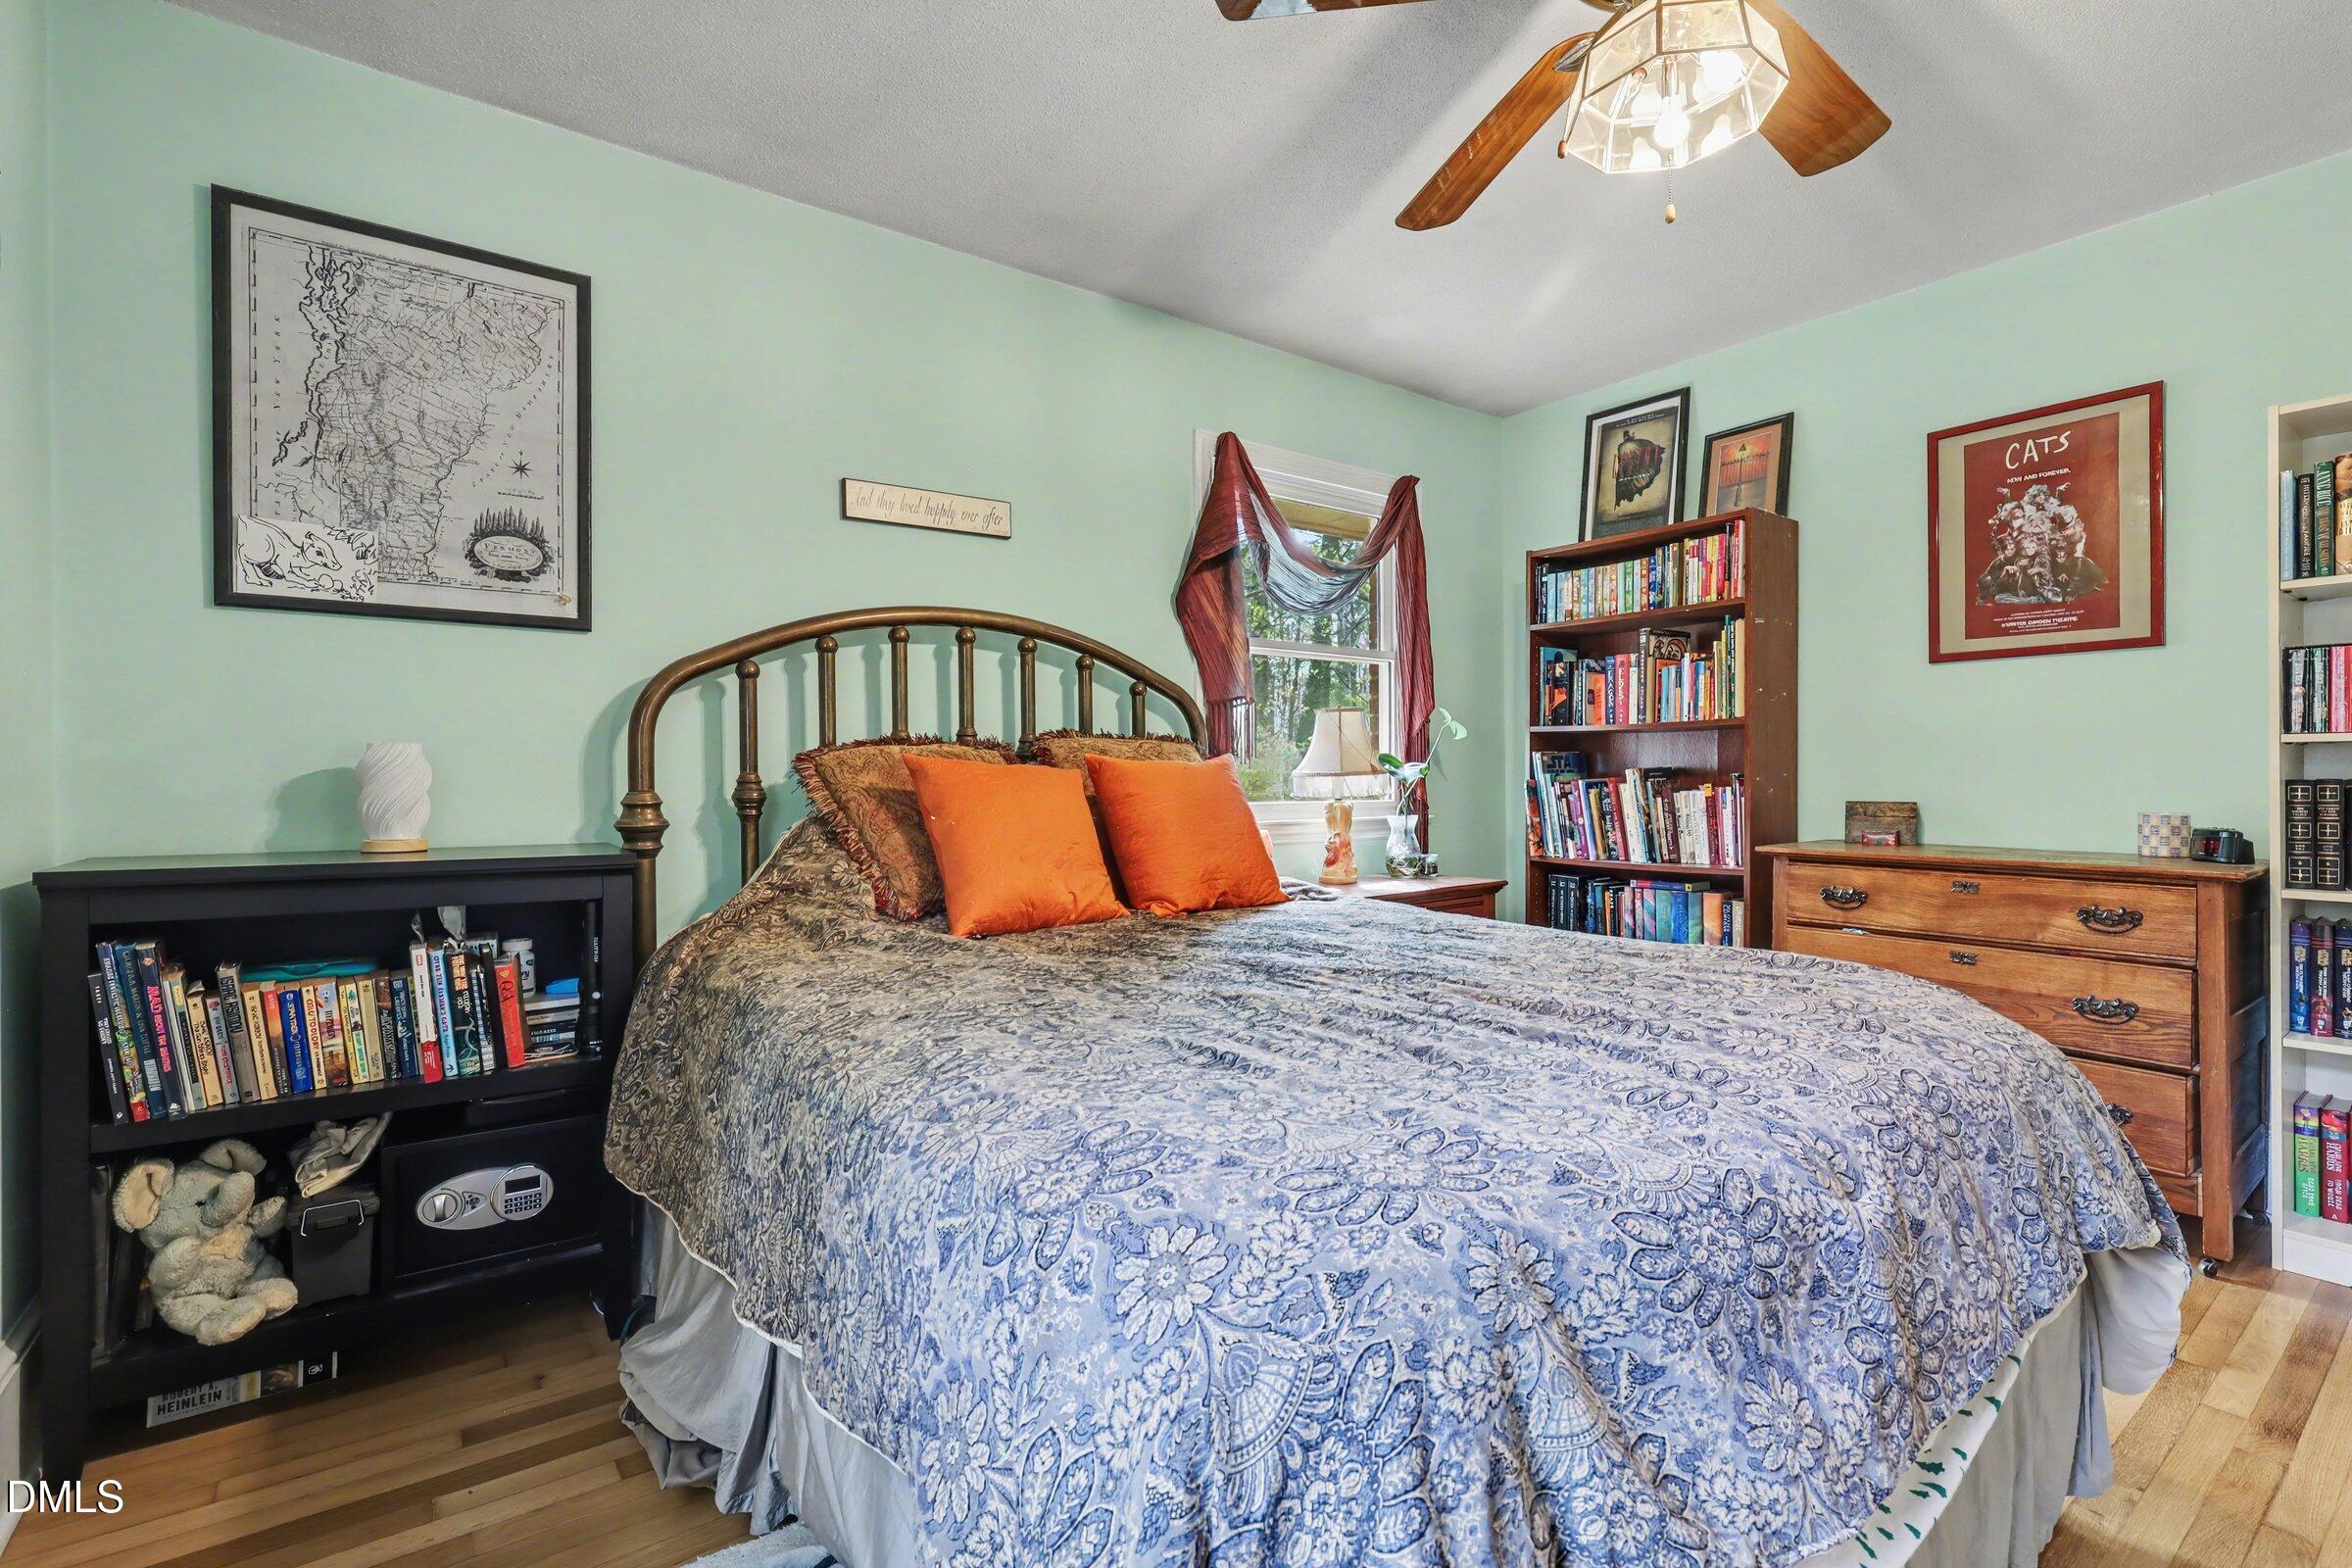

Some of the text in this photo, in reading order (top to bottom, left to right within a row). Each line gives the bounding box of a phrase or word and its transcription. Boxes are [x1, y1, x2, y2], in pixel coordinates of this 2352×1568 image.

[2005, 429, 2072, 469] CATS
[2007, 475, 2022, 484] NOW
[2317, 471, 2330, 506] ANNE RICE
[852, 486, 1003, 530] And they lived happily ever after
[108, 979, 120, 1005] FANTASTIC
[146, 984, 164, 1013] MAD
[220, 975, 237, 1001] ISAAC
[224, 1001, 243, 1034] ASIMOV
[2298, 1137, 2308, 1172] HARRIS
[2327, 1143, 2335, 1170] HARRIS
[157, 1391, 222, 1415] HEINLEIN
[163, 1385, 203, 1401] ROBERT
